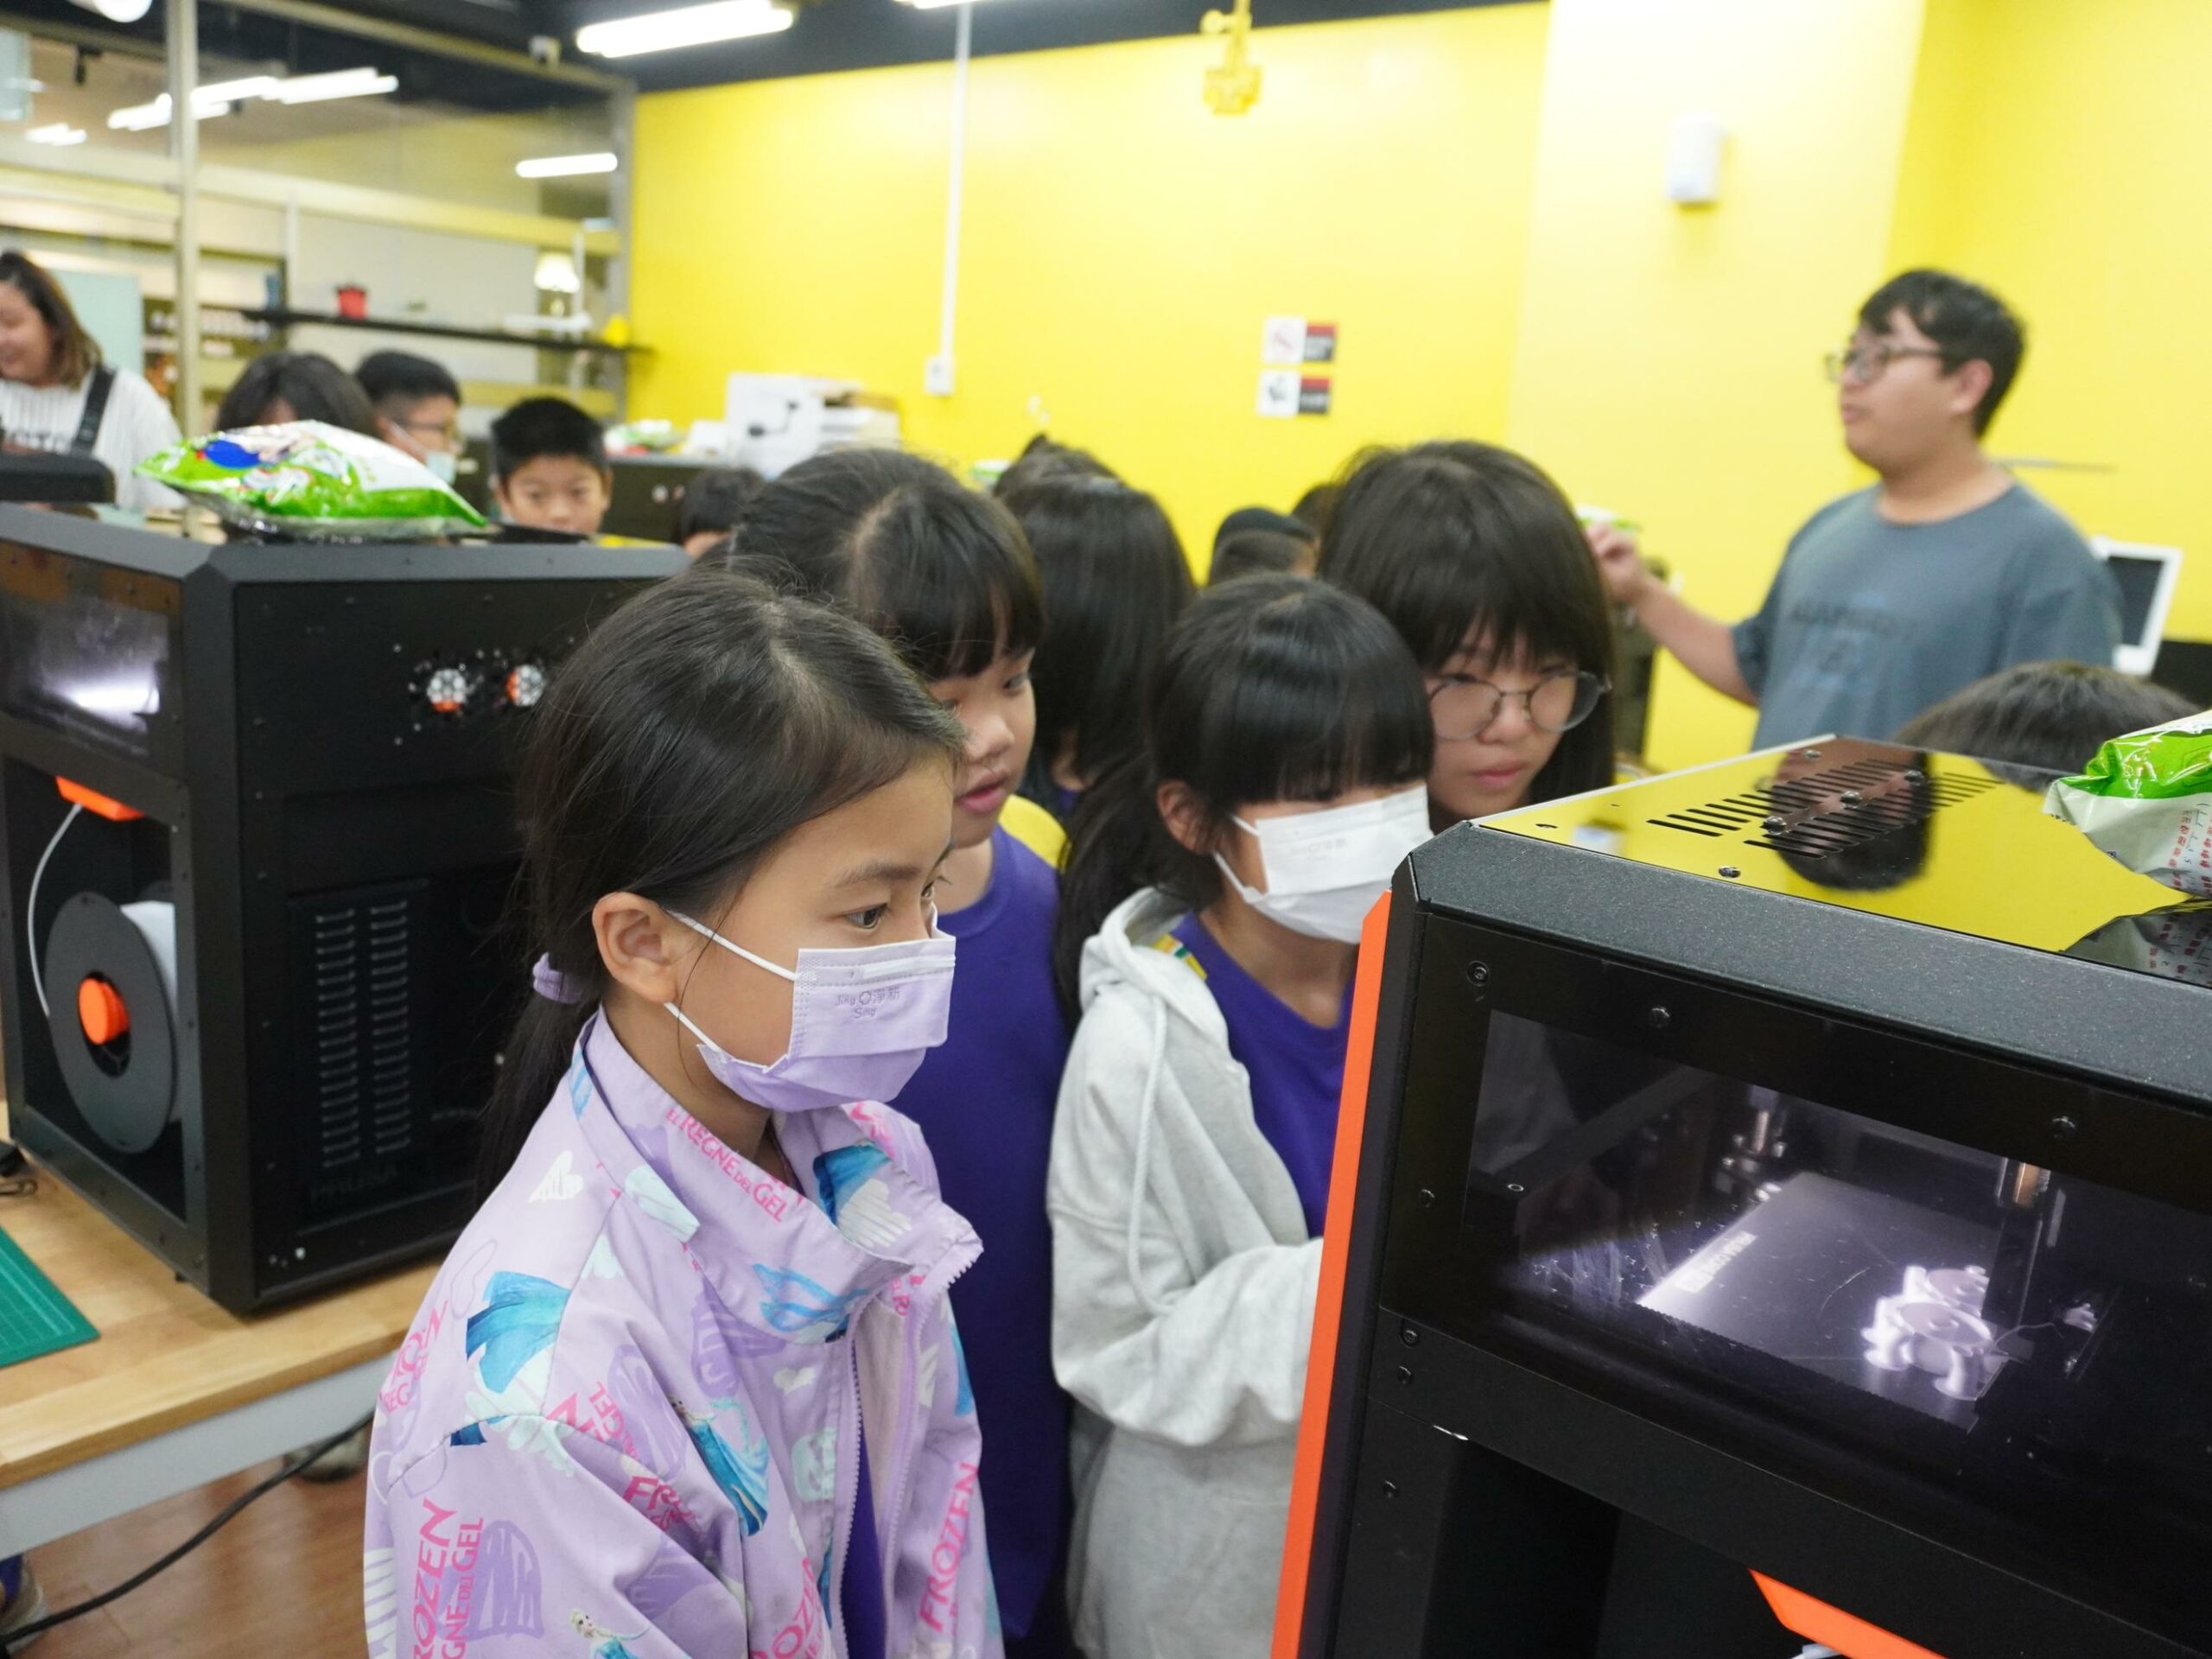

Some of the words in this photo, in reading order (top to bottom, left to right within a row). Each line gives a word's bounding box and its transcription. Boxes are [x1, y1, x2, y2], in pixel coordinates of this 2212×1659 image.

[835, 995, 856, 1007] Jing
[679, 1115, 741, 1177] REGNE
[733, 1171, 753, 1194] DEL
[753, 1182, 788, 1223] GEL
[588, 1381, 625, 1440] GEL
[451, 1517, 484, 1572] GEL
[918, 1461, 979, 1632] FROZEN
[457, 1576, 475, 1602] DEL
